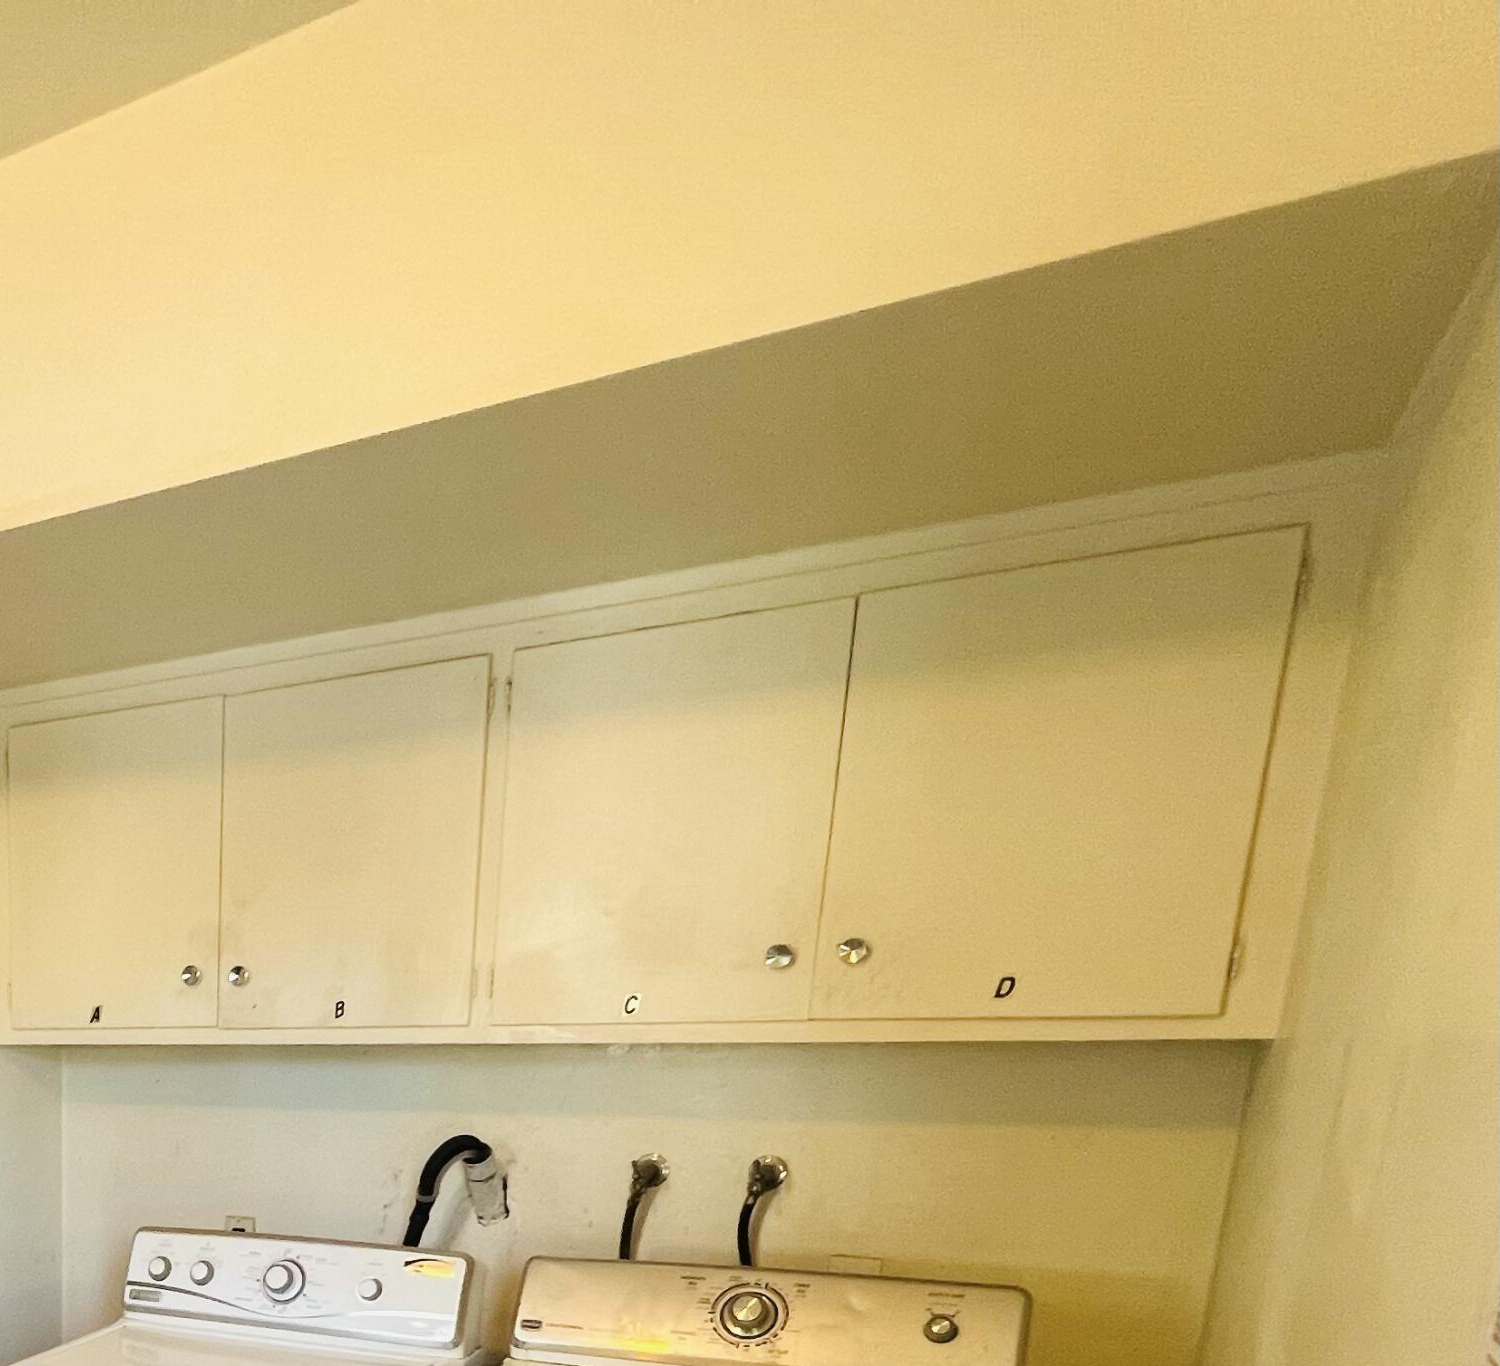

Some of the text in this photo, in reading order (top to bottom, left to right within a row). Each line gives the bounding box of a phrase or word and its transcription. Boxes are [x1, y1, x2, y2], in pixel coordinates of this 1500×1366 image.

[994, 976, 1016, 998] D
[334, 1000, 345, 1019] B
[624, 995, 638, 1014] C
[89, 1005, 103, 1024] A
